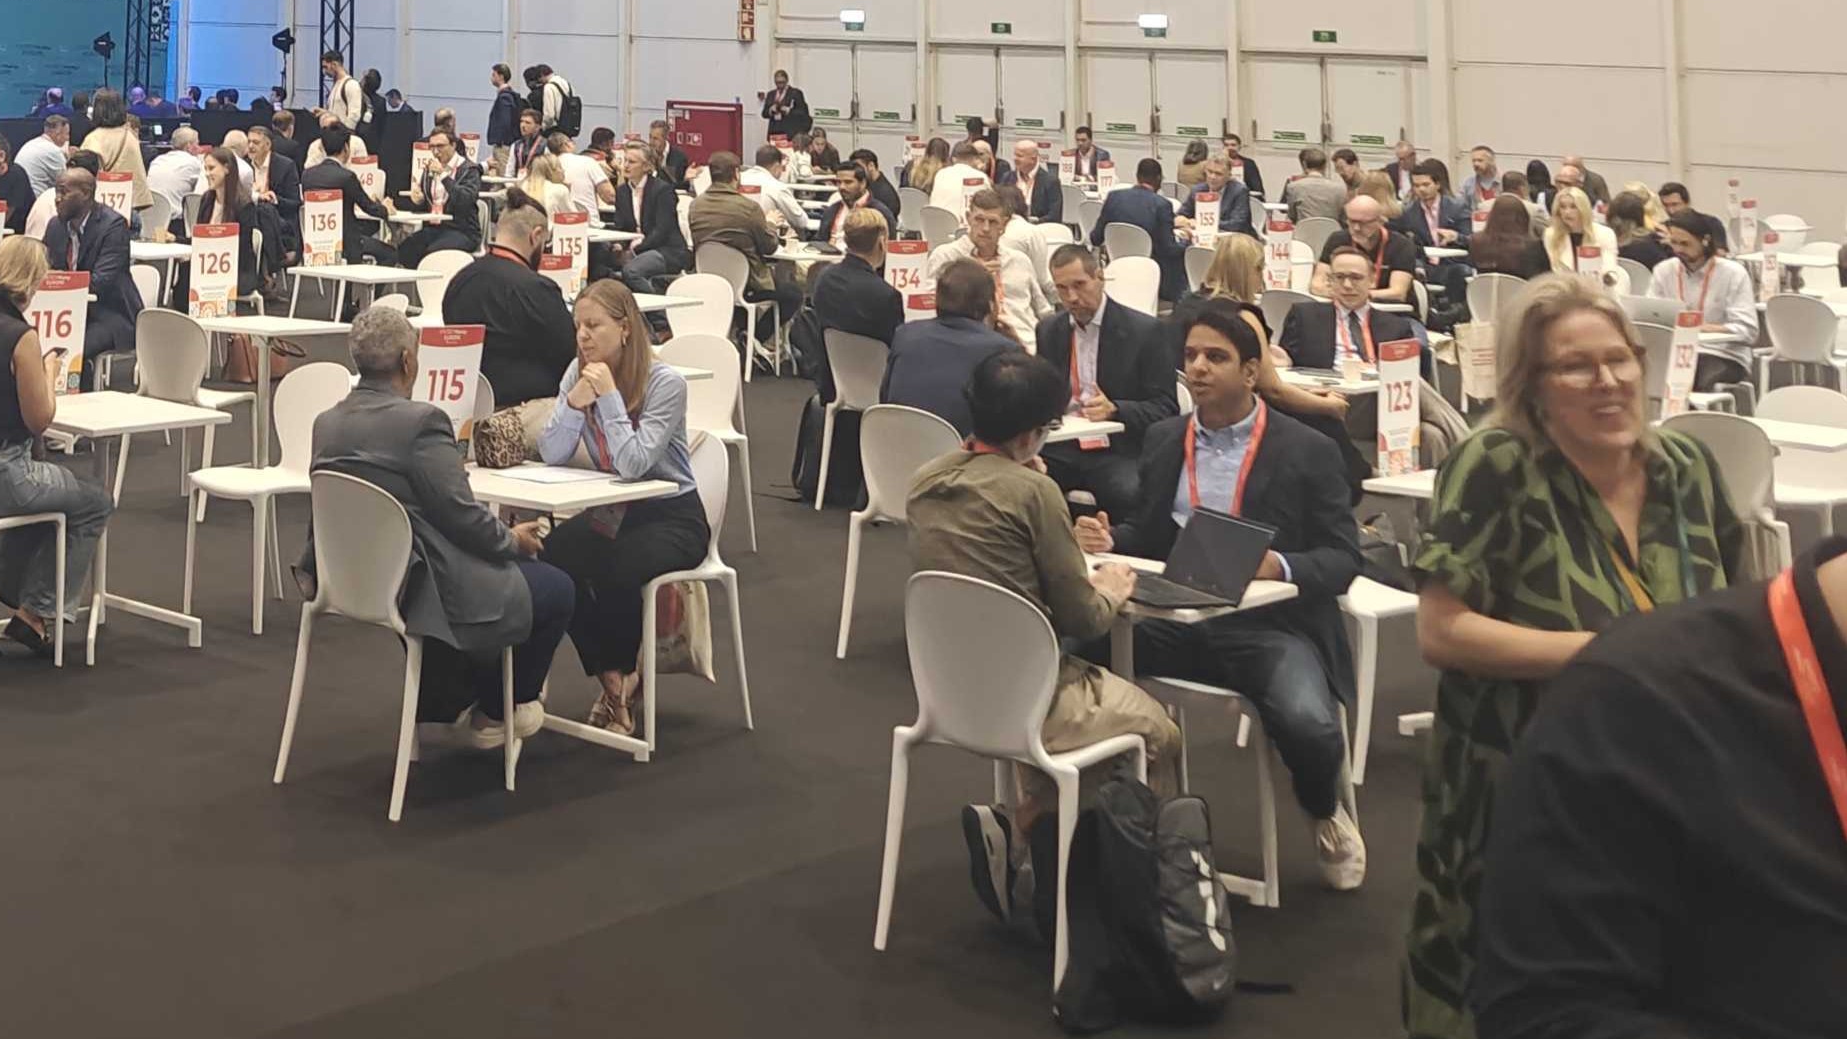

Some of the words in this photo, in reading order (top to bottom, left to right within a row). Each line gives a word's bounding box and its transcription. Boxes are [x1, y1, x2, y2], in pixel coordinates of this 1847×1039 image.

[101, 192, 126, 209] 137
[311, 213, 337, 232] 136
[558, 237, 582, 255] 135
[1272, 243, 1289, 260] 144
[199, 252, 231, 275] 126
[891, 268, 920, 289] 134
[32, 310, 72, 338] 116
[428, 369, 465, 401] 115
[1386, 381, 1412, 413] 123
